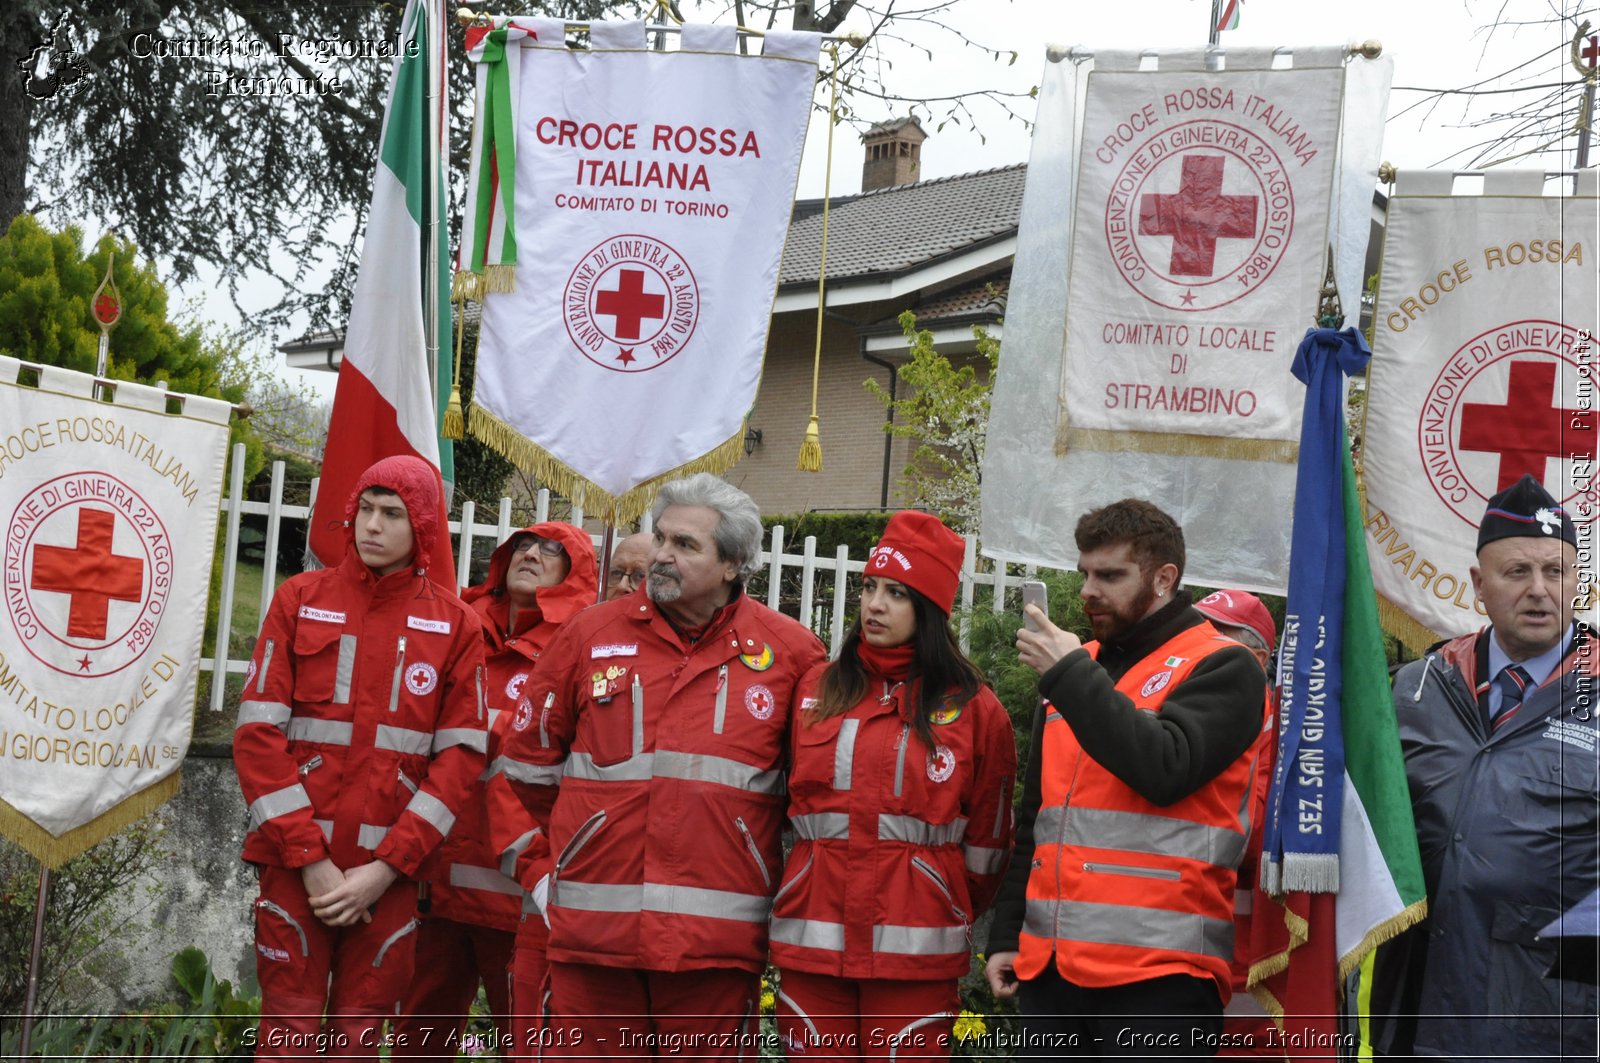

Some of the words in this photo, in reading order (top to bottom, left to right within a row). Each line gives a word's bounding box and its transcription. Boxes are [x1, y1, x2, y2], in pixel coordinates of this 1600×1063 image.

[536, 116, 638, 151] CROCE
[652, 124, 761, 159] ROSSA
[1096, 103, 1159, 165] CROCE
[1164, 87, 1235, 115] ROSSA
[1242, 94, 1318, 167] ITALIANA
[1170, 126, 1249, 154] GINEVRA
[1149, 138, 1168, 160] DI
[1247, 145, 1272, 171] 22
[576, 159, 711, 192] ITALIANA
[555, 193, 635, 212] COMITATO
[640, 198, 657, 213] DI
[664, 200, 729, 219] TORINO
[1110, 154, 1152, 282] CONVENZIONE
[1264, 168, 1289, 249] AGOSTO
[592, 249, 610, 269] DI
[610, 240, 670, 269] GINEVRA
[666, 263, 685, 282] 22
[1237, 252, 1273, 288] 1864
[1387, 259, 1473, 333] CROCE
[1484, 239, 1583, 270] ROSSA
[568, 263, 605, 352] CONVENZIONE
[671, 283, 694, 334] AGOSTO
[650, 331, 679, 359] 1864
[1102, 323, 1190, 347] COMITATO
[1199, 326, 1276, 352] LOCALE
[1170, 353, 1188, 375] DI
[1104, 382, 1257, 417] STRAMBINO
[1424, 356, 1474, 504] CONVENZIONE
[1470, 340, 1494, 364] DI
[0, 422, 56, 479] ROCE
[56, 417, 125, 450] ROSSA
[128, 431, 199, 508] ITALIANA
[41, 486, 62, 508] DI
[64, 478, 135, 514] GINEVRA
[132, 508, 155, 533] 22
[8, 499, 45, 641] CONVENZIONE
[148, 533, 170, 616] AGOSTO
[126, 617, 156, 654] 1864
[82, 675, 159, 733] LOCALE
[151, 653, 181, 683] DI
[1298, 748, 1325, 789] SAN
[1298, 793, 1323, 836] SEZ.
